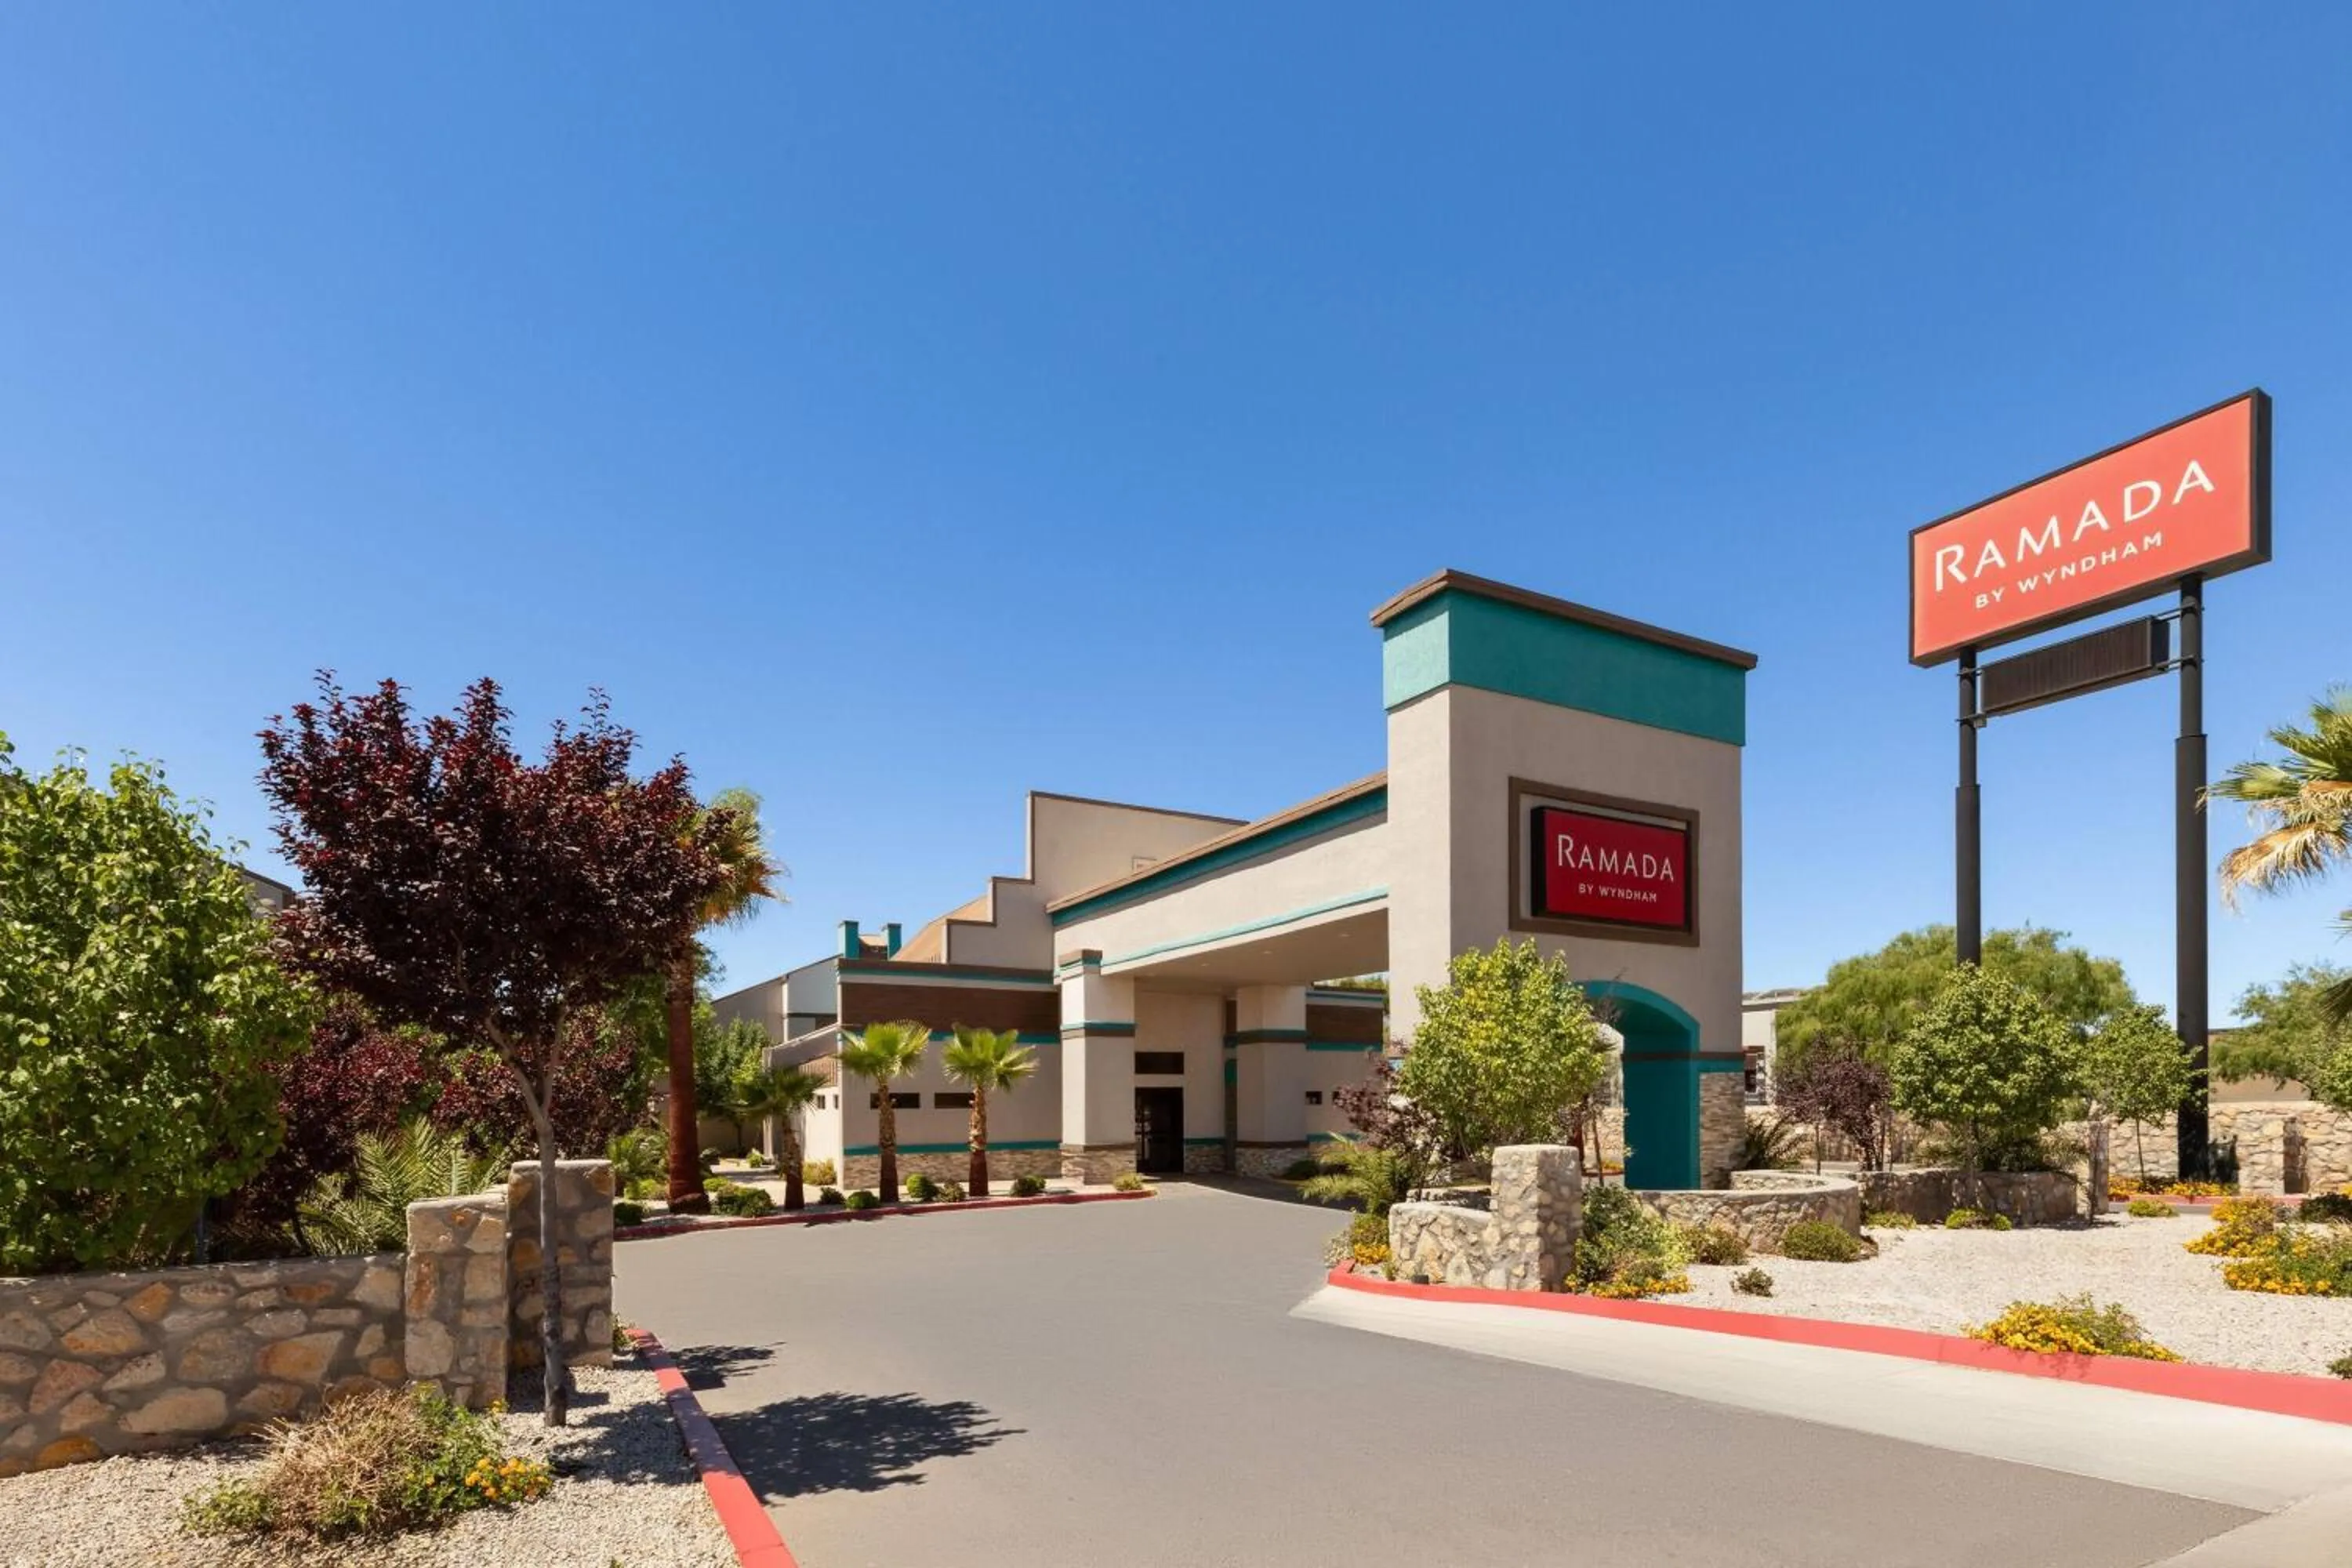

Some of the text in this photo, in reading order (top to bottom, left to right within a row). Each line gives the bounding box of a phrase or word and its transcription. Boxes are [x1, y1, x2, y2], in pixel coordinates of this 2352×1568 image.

[1935, 460, 2215, 592] RAMADA
[1975, 532, 2162, 608] BY WYNDHAM
[1558, 834, 1674, 882] RAMADA
[1578, 884, 1657, 902] BY WYNDHAM
